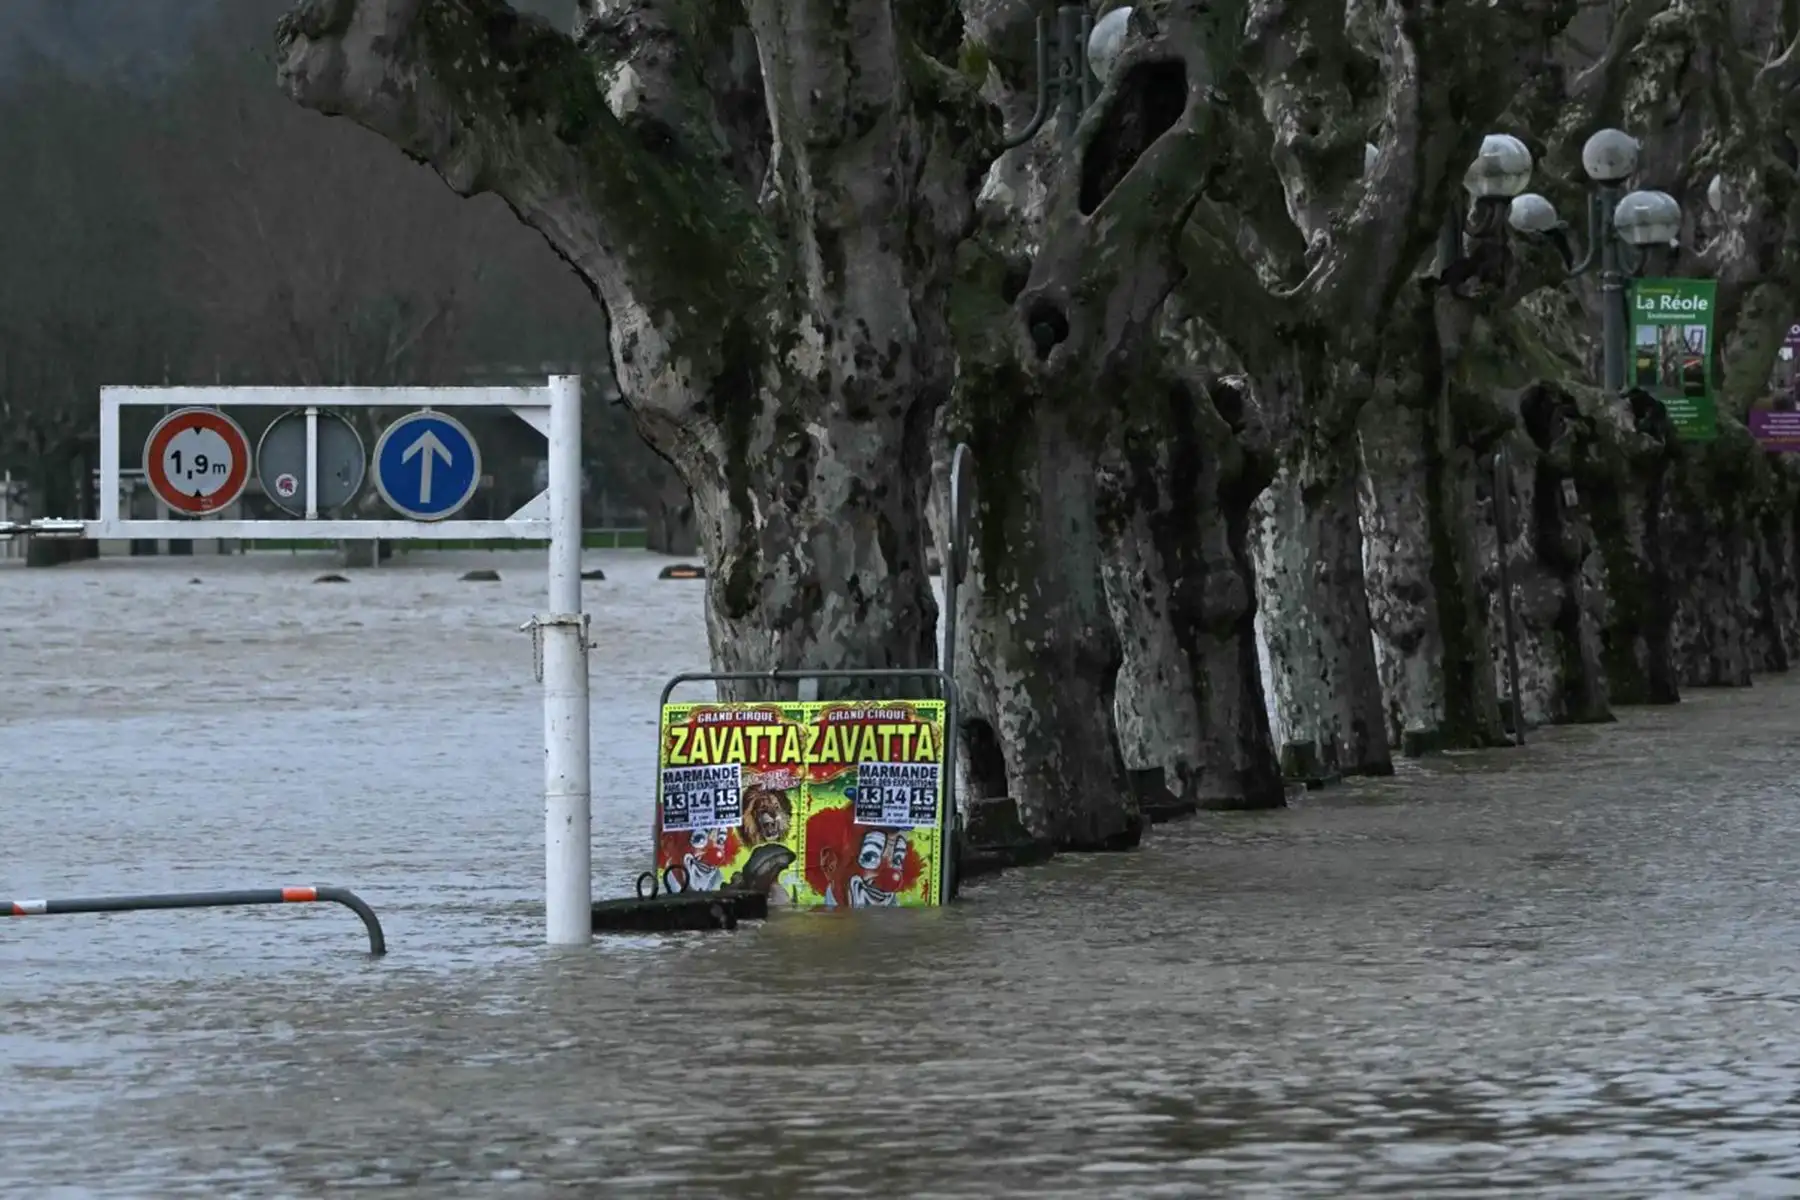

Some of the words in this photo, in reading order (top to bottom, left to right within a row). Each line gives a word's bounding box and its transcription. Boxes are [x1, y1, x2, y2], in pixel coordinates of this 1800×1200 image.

[1636, 294, 1655, 310] La
[1660, 289, 1708, 311] Réole
[171, 450, 209, 480] 1,9
[212, 462, 227, 475] m
[697, 712, 733, 723] GRAND
[736, 711, 774, 722] CIRQUE
[828, 710, 864, 721] GRAND
[867, 709, 907, 720] CIRQUE
[670, 725, 802, 764] ZAVATTA
[806, 723, 935, 763] ZAVATTA
[662, 766, 740, 784] MARMANDE
[859, 764, 938, 779] MARMANDE
[665, 793, 687, 810] 13
[689, 791, 712, 808] 14
[715, 788, 738, 806] 15
[860, 787, 882, 804] 13
[884, 788, 907, 805] 14
[912, 788, 935, 805] 15
